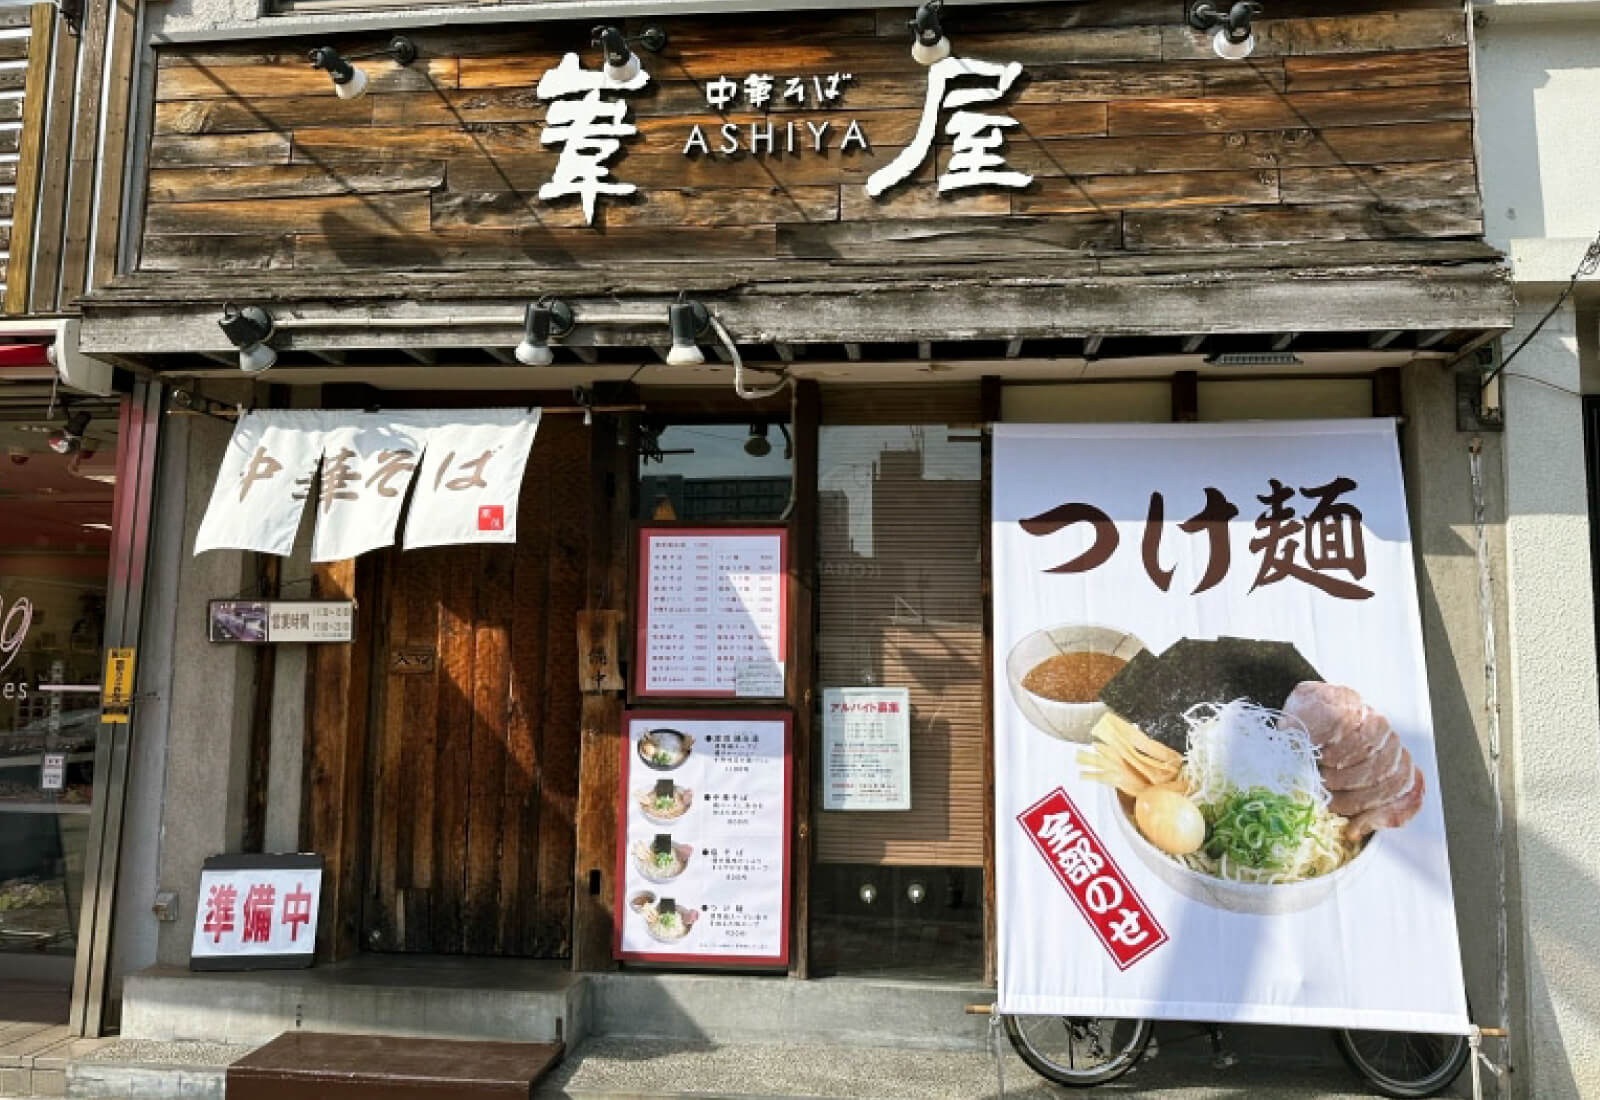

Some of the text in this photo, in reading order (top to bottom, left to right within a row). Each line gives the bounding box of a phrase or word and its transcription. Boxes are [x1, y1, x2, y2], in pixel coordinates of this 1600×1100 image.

[706, 72, 853, 110] 中華そば
[683, 120, 868, 154] ASHIYA
[239, 444, 504, 514] 中華そば
[1018, 476, 1376, 600] つけ麺
[203, 881, 312, 943] 準備中
